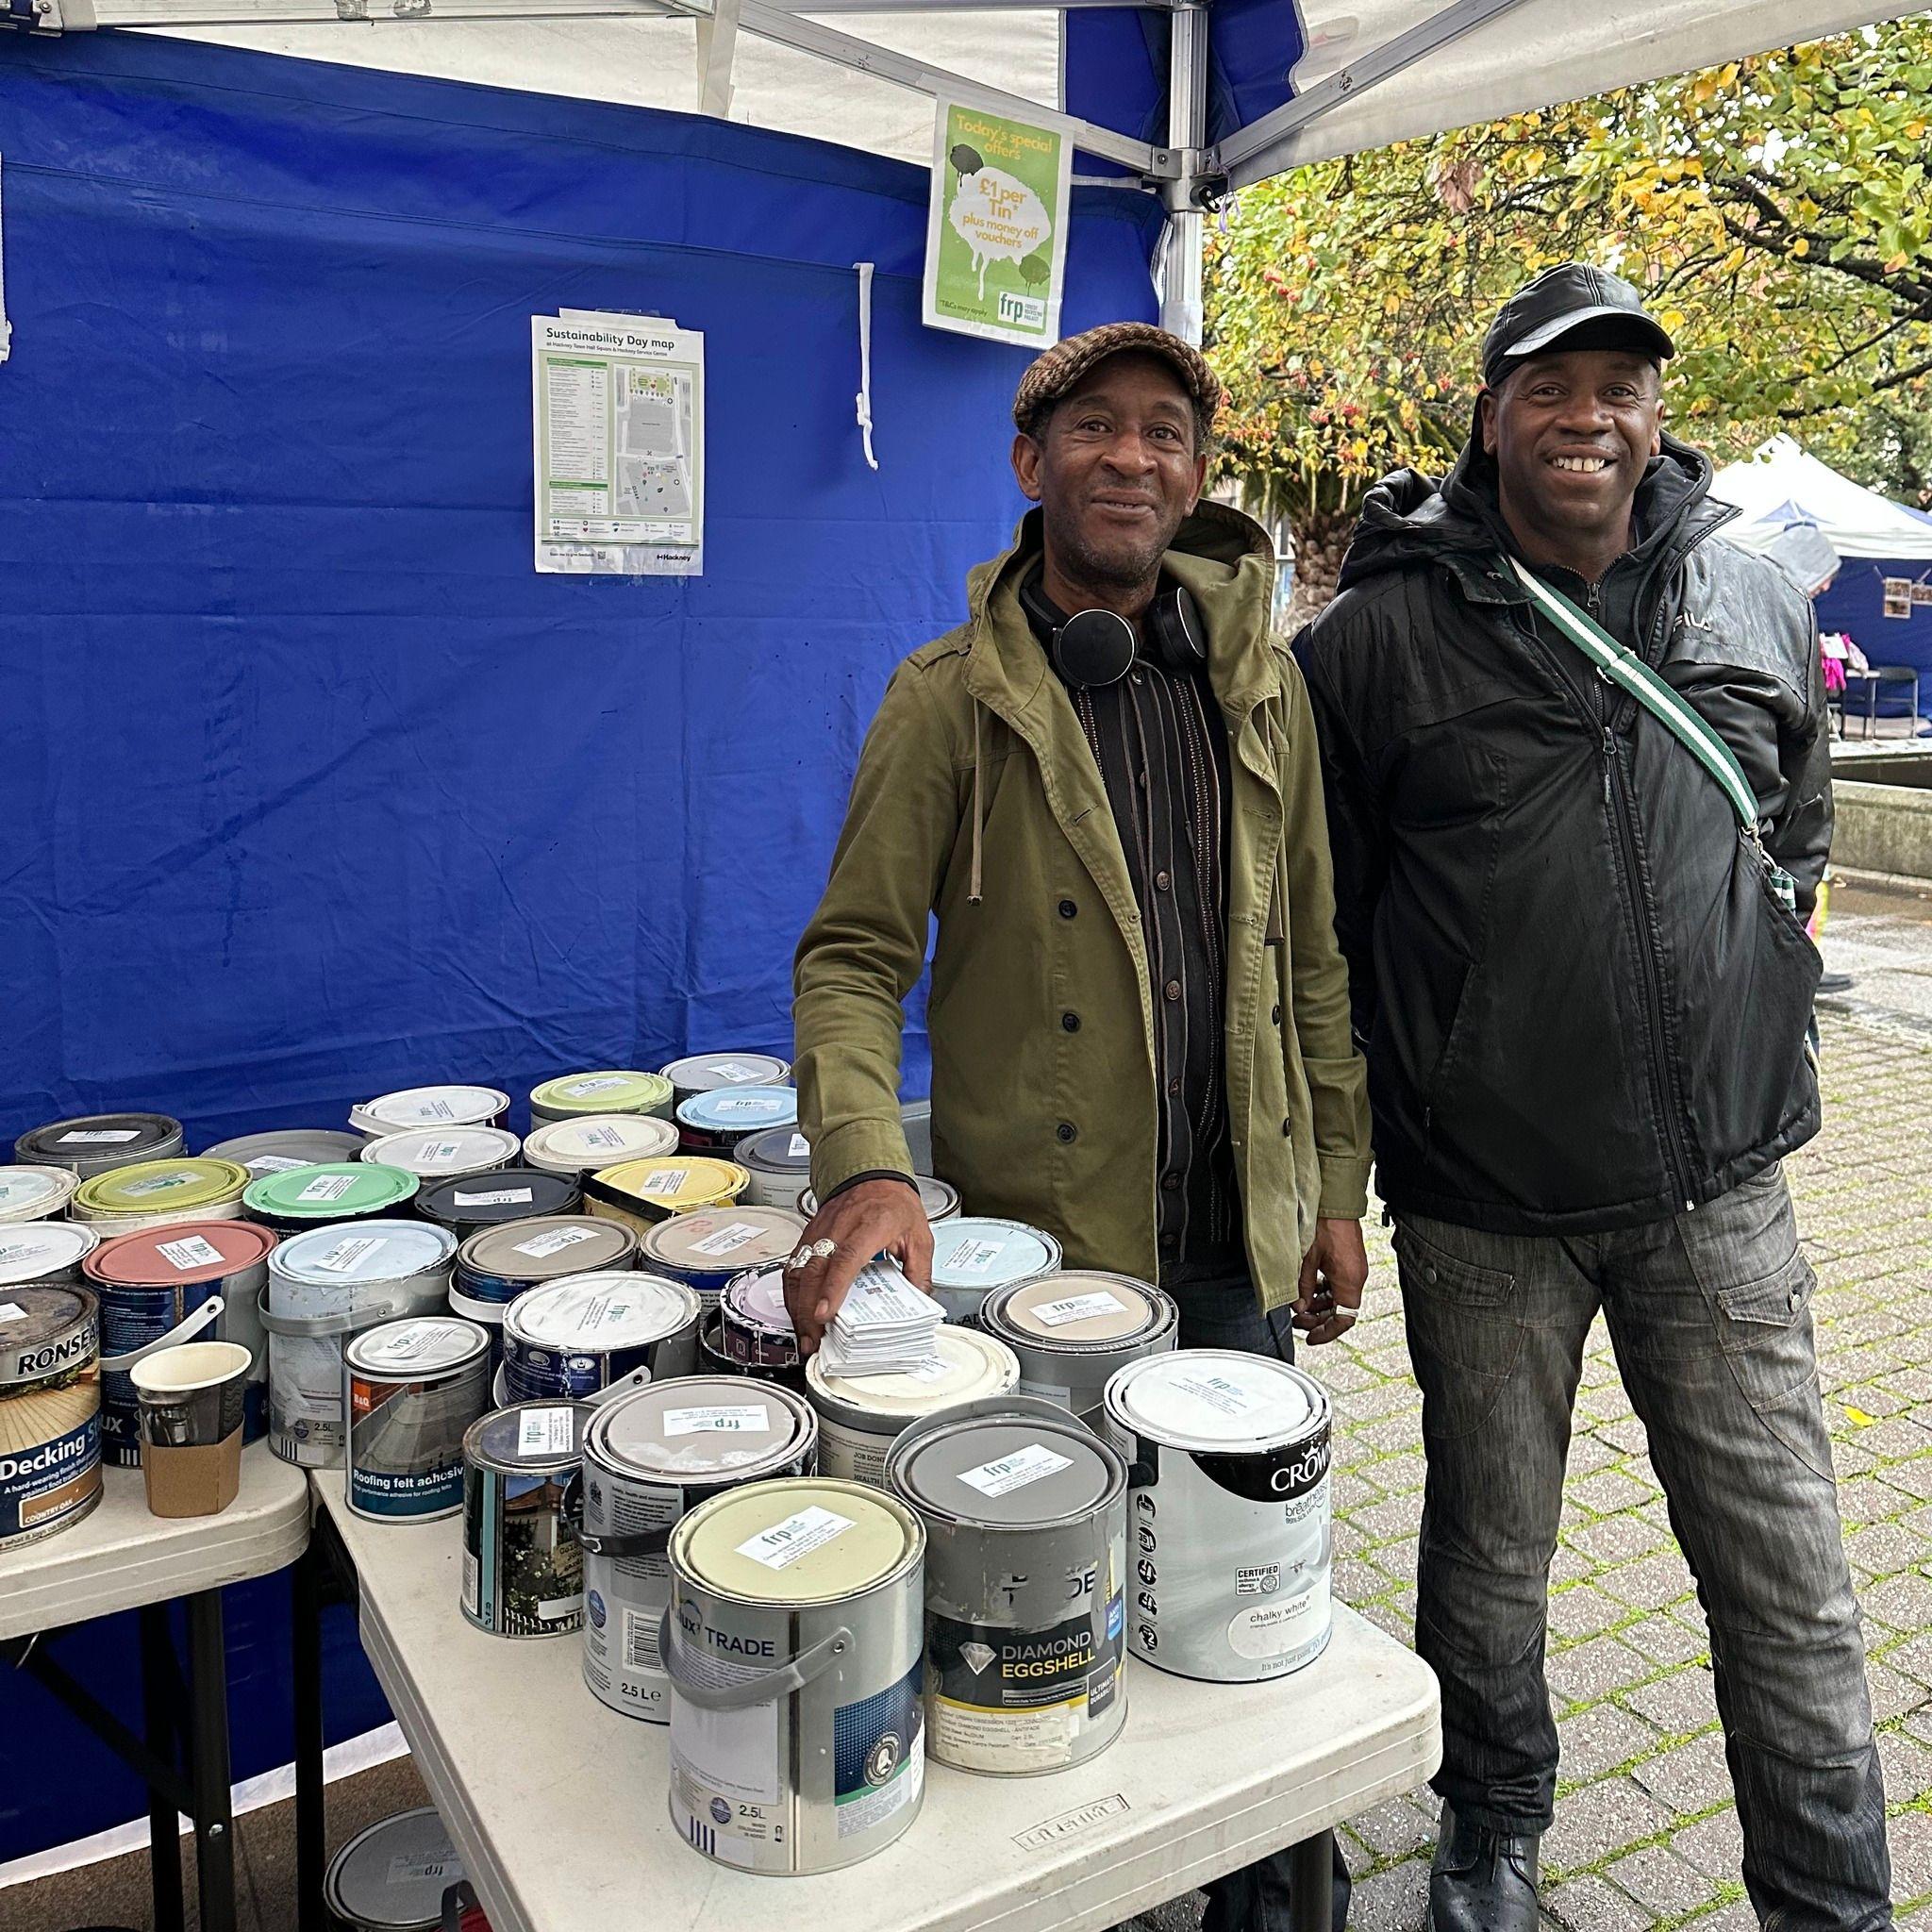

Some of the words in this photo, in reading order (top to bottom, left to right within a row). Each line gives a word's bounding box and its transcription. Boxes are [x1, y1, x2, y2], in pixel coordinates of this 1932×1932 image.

[956, 114, 1008, 142] Today's
[1010, 134, 1052, 152] special
[984, 140, 1022, 159] offers
[979, 177, 998, 197] £1
[1000, 189, 1026, 205] per
[962, 212, 985, 226] plus
[987, 221, 1023, 238] money
[1024, 227, 1039, 239] off
[975, 230, 1023, 248] vouchers
[1000, 293, 1023, 322] frp
[546, 327, 624, 346] Sustainability
[627, 336, 649, 349] Day
[651, 340, 675, 351] map
[17, 1323, 98, 1375] RONSEA
[354, 1393, 370, 1407] B&Q
[0, 1434, 86, 1481] Decking
[354, 1469, 391, 1490] Roofing
[393, 1477, 414, 1489] felt
[854, 1474, 880, 1485] HEALTH
[983, 1463, 1011, 1476] frp
[12, 1472, 59, 1492] hard-wearing
[21, 1486, 48, 1499] against
[49, 1479, 62, 1489] foot
[761, 1529, 793, 1545] frp
[1238, 1565, 1278, 1578] CERTIFIED
[1250, 1609, 1283, 1623] chalky
[705, 1626, 774, 1657] TRADE
[1002, 1631, 1091, 1660] DIAMOND
[1002, 1647, 1096, 1678] EGGSHELL
[1273, 1660, 1284, 1669] not
[1285, 1655, 1297, 1667] just
[622, 1682, 638, 1697] 2.5
[1090, 1674, 1115, 1697] ULTIMATE
[739, 1804, 767, 1820] 2.5L
